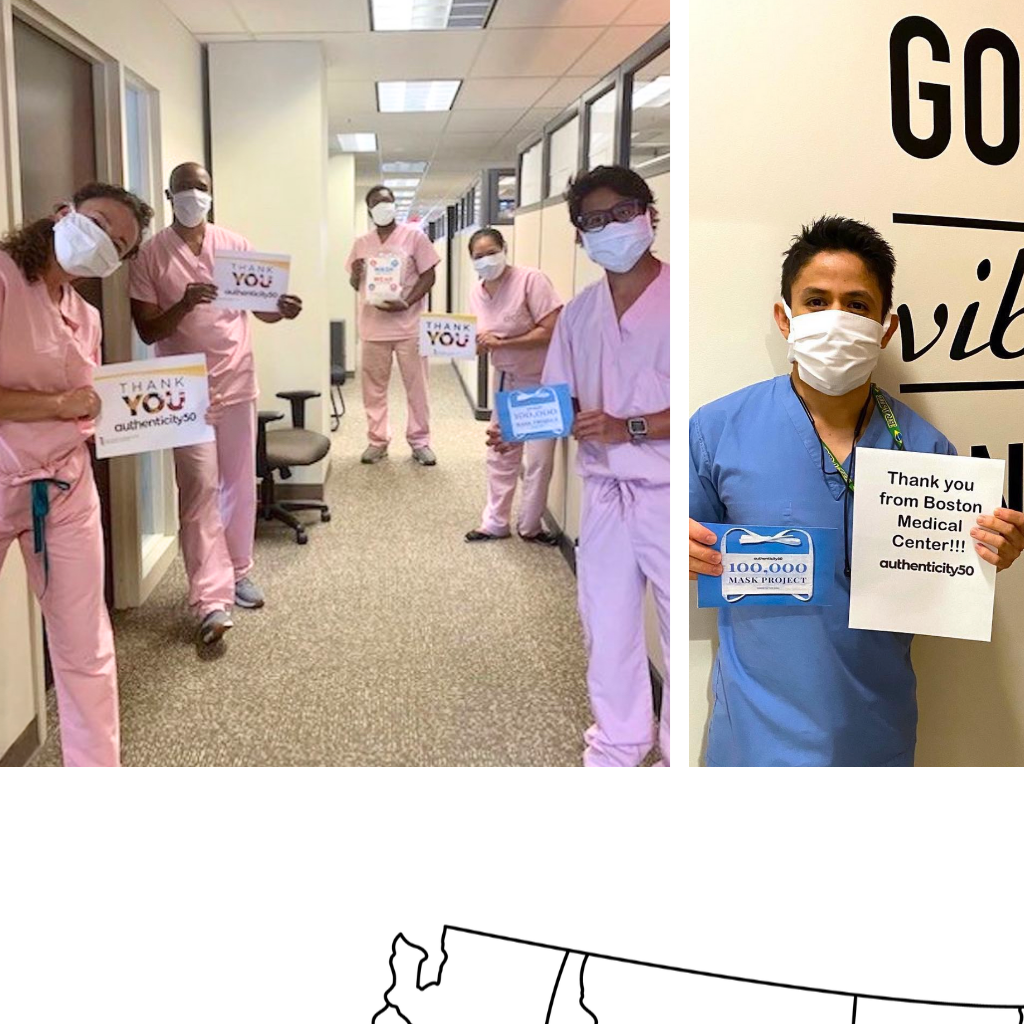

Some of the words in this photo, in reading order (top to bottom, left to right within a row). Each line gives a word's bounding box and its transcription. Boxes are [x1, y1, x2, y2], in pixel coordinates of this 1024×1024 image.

[232, 271, 273, 288] YOU
[426, 321, 470, 331] THANK
[427, 330, 469, 347] YOU
[120, 377, 185, 393] THANK
[122, 391, 185, 416] YOU
[114, 412, 197, 432] authenticity50
[887, 471, 940, 489] Thank
[943, 479, 974, 493] you
[879, 491, 919, 508] from
[924, 495, 982, 514] Boston
[897, 514, 963, 532] Medical
[892, 534, 965, 553] Center!!!
[728, 562, 808, 574] 100,000
[879, 559, 975, 577] authenticity50
[728, 576, 758, 584] MASK
[761, 576, 807, 585] PROJECT
